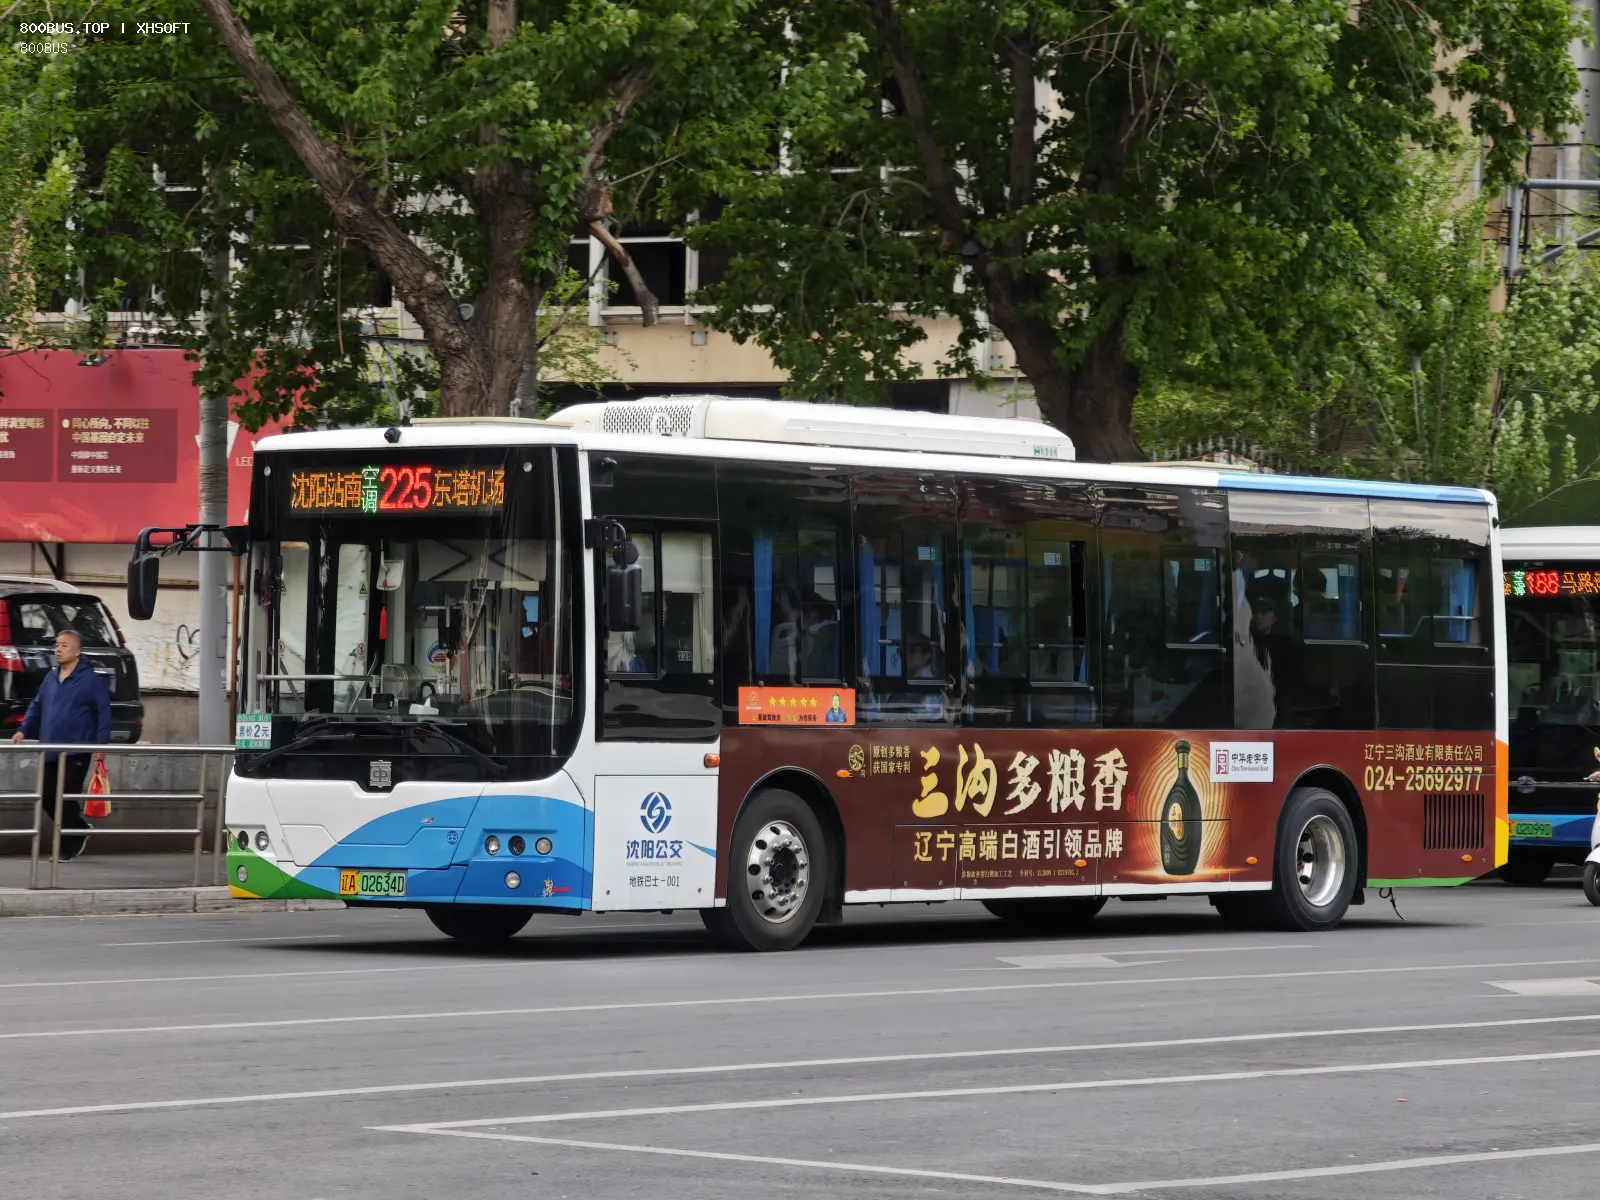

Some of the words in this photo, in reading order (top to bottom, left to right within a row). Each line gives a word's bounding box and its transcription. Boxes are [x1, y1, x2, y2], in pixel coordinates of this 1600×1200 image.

[291, 471, 362, 509] 沈阳站南
[361, 465, 380, 513] 空调
[379, 467, 432, 509] 225
[432, 469, 505, 507] 东塔机场
[872, 744, 911, 759] 原创多粮香
[1231, 752, 1269, 765] 中华老字号
[1364, 743, 1483, 762] 辽宁三沟酒业有限责任公司
[872, 760, 911, 774] 获国家专利
[911, 741, 1130, 819] 三沟多粮香
[1364, 765, 1483, 792] 024-25692977
[626, 839, 683, 859] 沈阳公交
[912, 828, 1124, 863] 辽宁高端白酒引领品牌
[361, 874, 405, 893] 02634D
